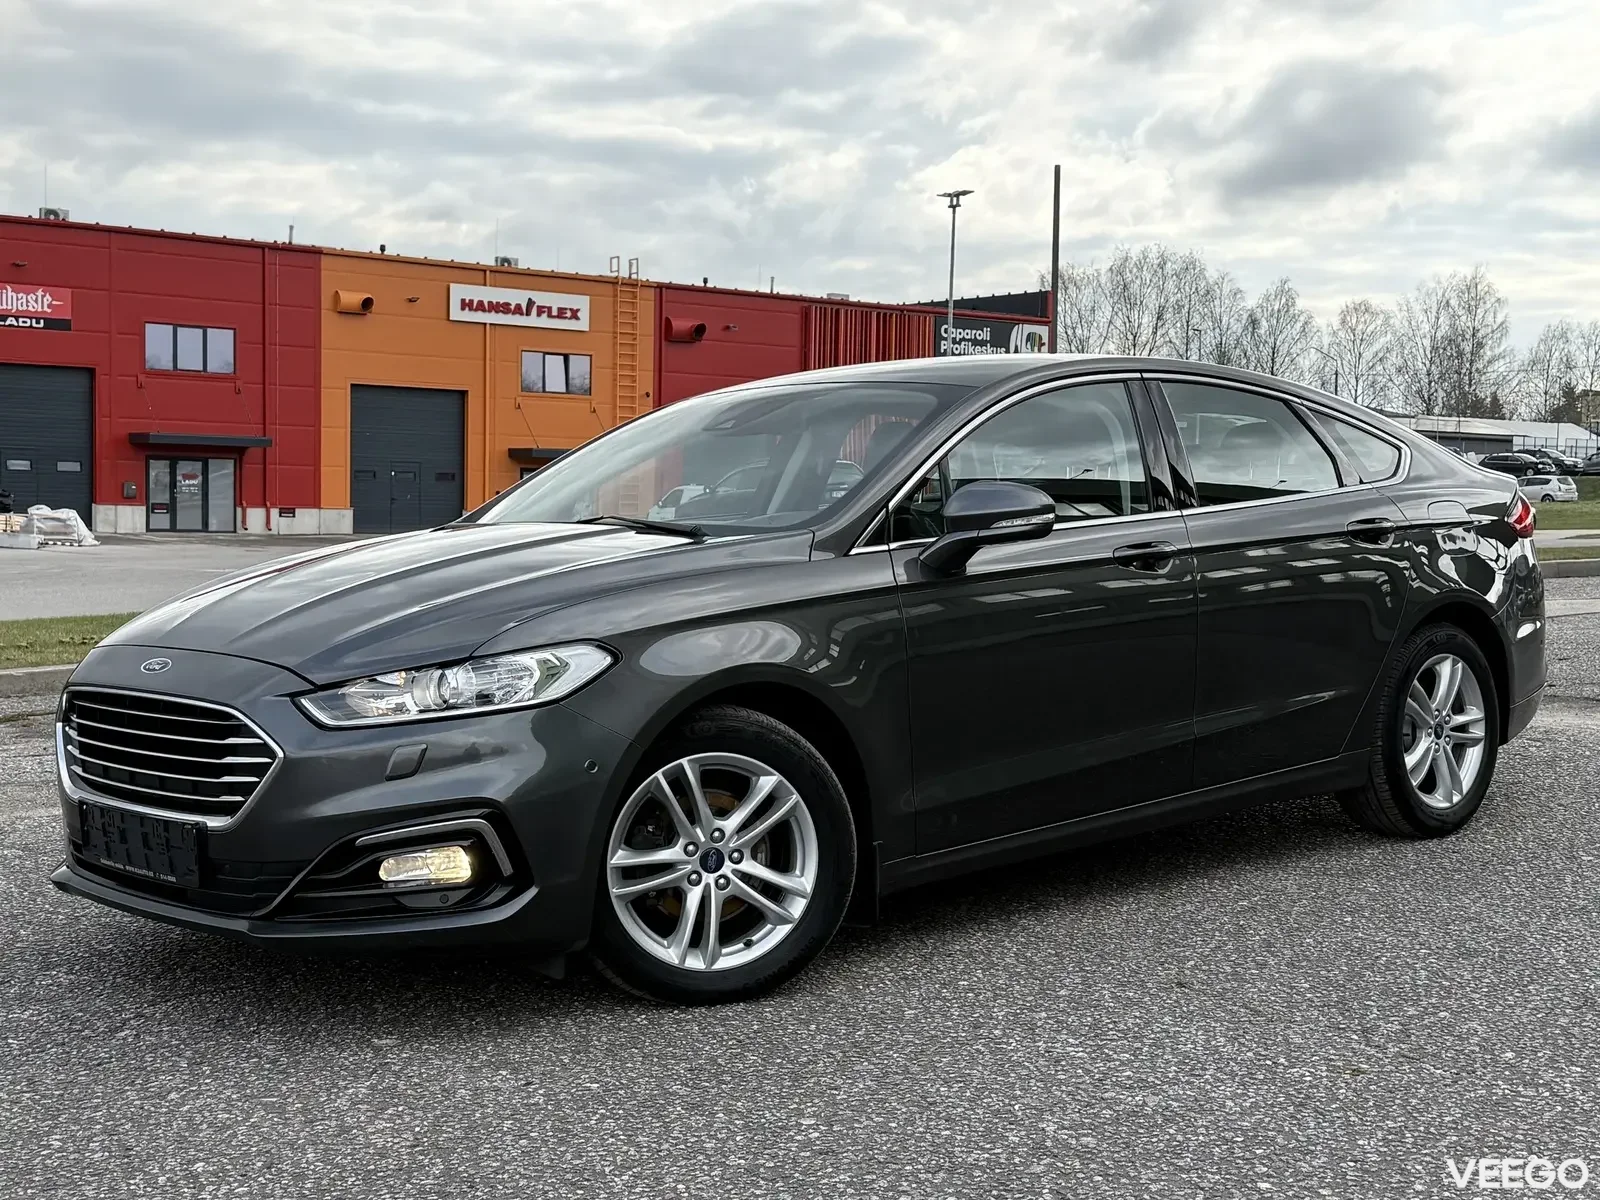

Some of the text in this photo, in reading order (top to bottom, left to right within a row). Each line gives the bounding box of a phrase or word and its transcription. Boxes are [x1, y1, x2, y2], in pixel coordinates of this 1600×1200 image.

[460, 298, 581, 321] HANSA FLEX
[940, 324, 991, 341] Caparoli
[940, 340, 1007, 355] Profikeskus
